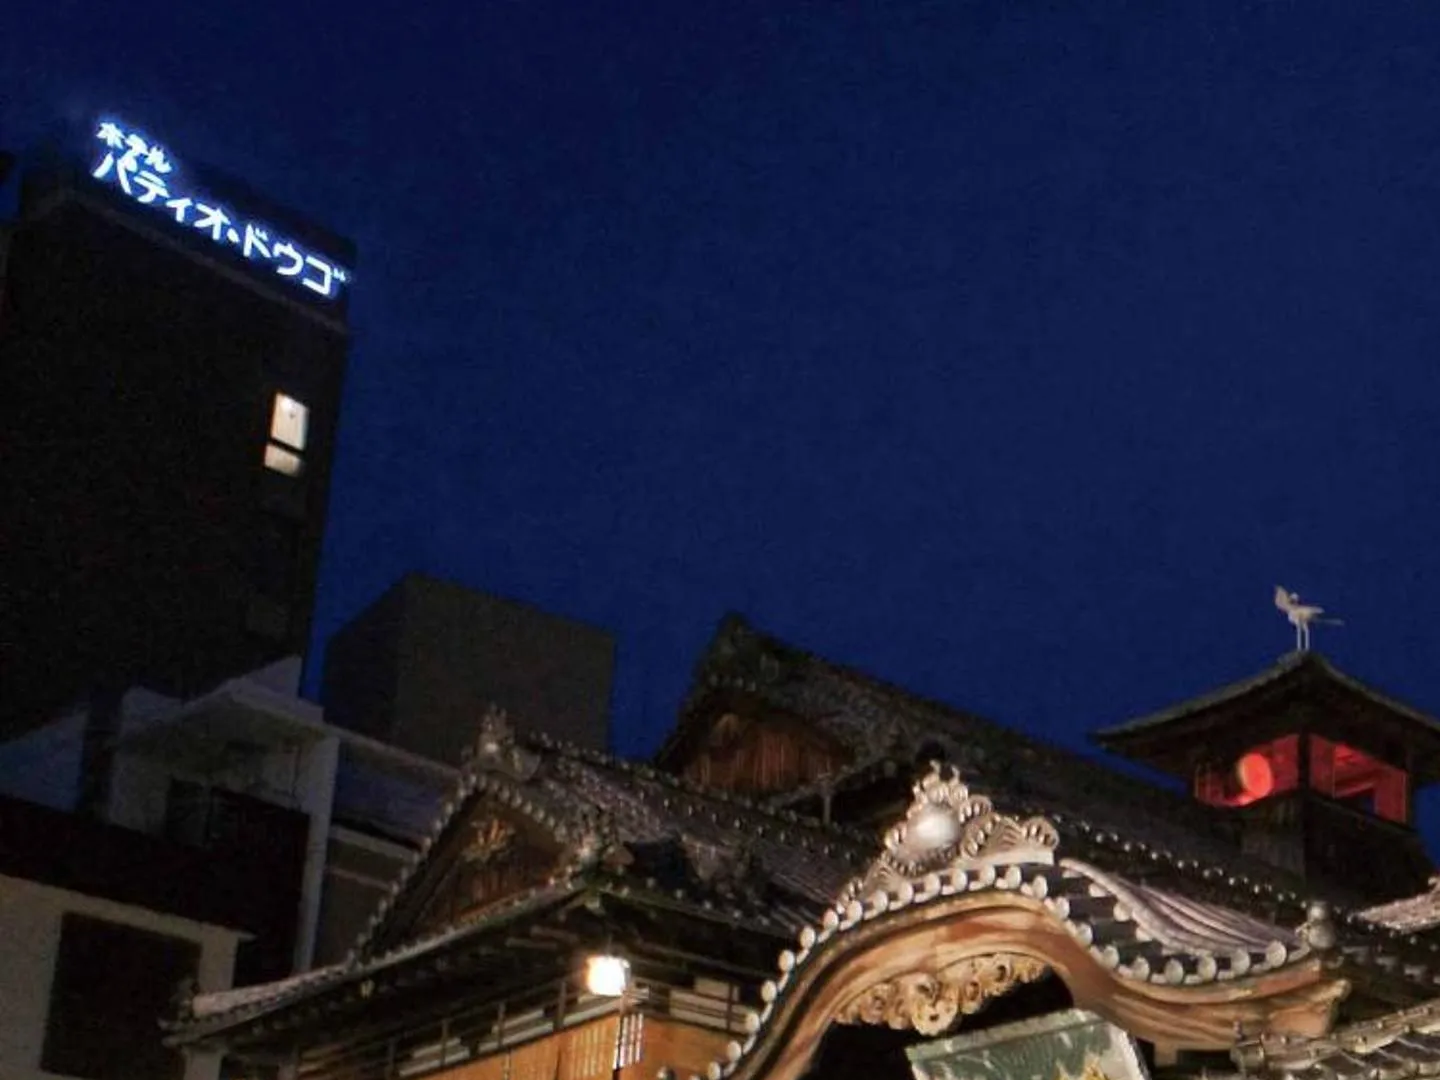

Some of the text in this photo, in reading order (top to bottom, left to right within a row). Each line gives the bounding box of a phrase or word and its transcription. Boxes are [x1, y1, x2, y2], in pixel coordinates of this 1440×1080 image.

[93, 152, 346, 295] パティオ・ドウゴ
